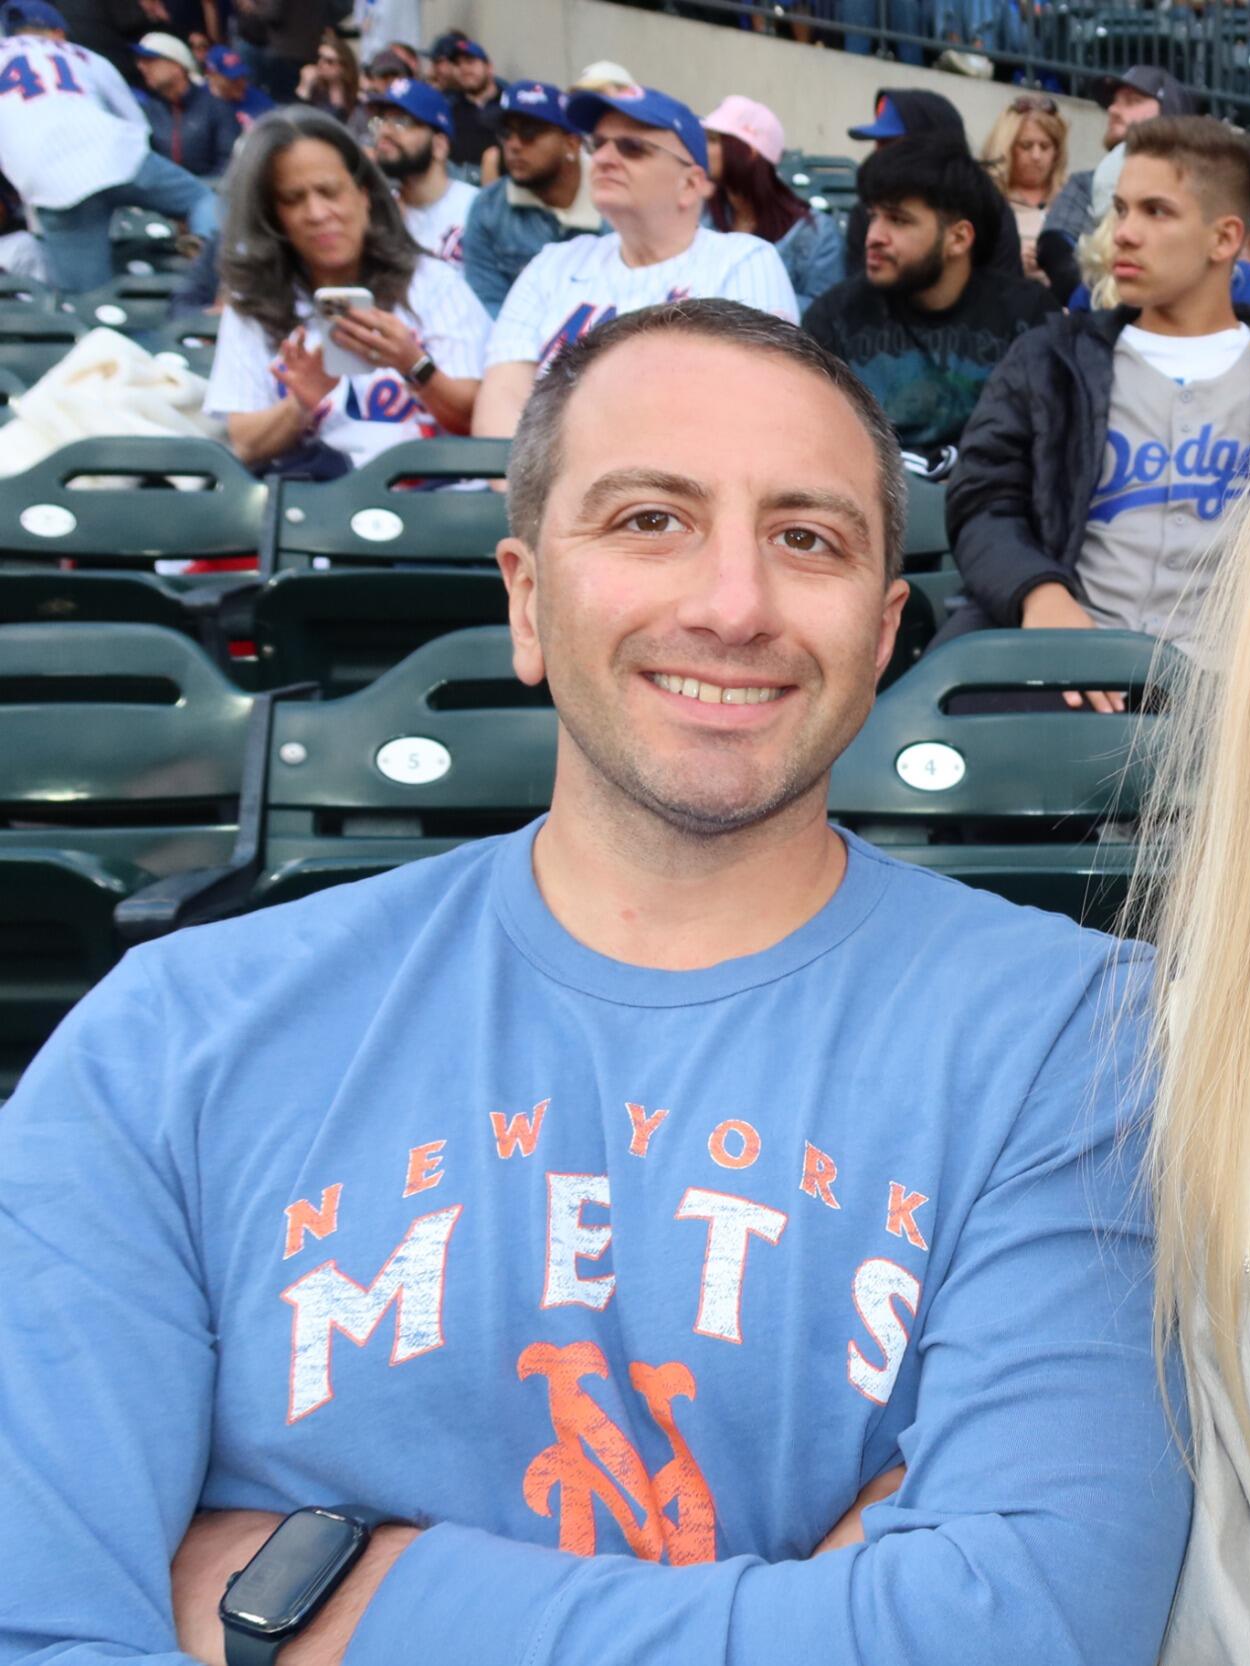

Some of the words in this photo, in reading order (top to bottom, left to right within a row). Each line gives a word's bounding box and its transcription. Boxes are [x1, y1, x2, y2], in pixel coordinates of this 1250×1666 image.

[0, 53, 84, 102] 41
[282, 1097, 552, 1261] NEW
[625, 1101, 931, 1252] YORK
[279, 1172, 922, 1426] METS
